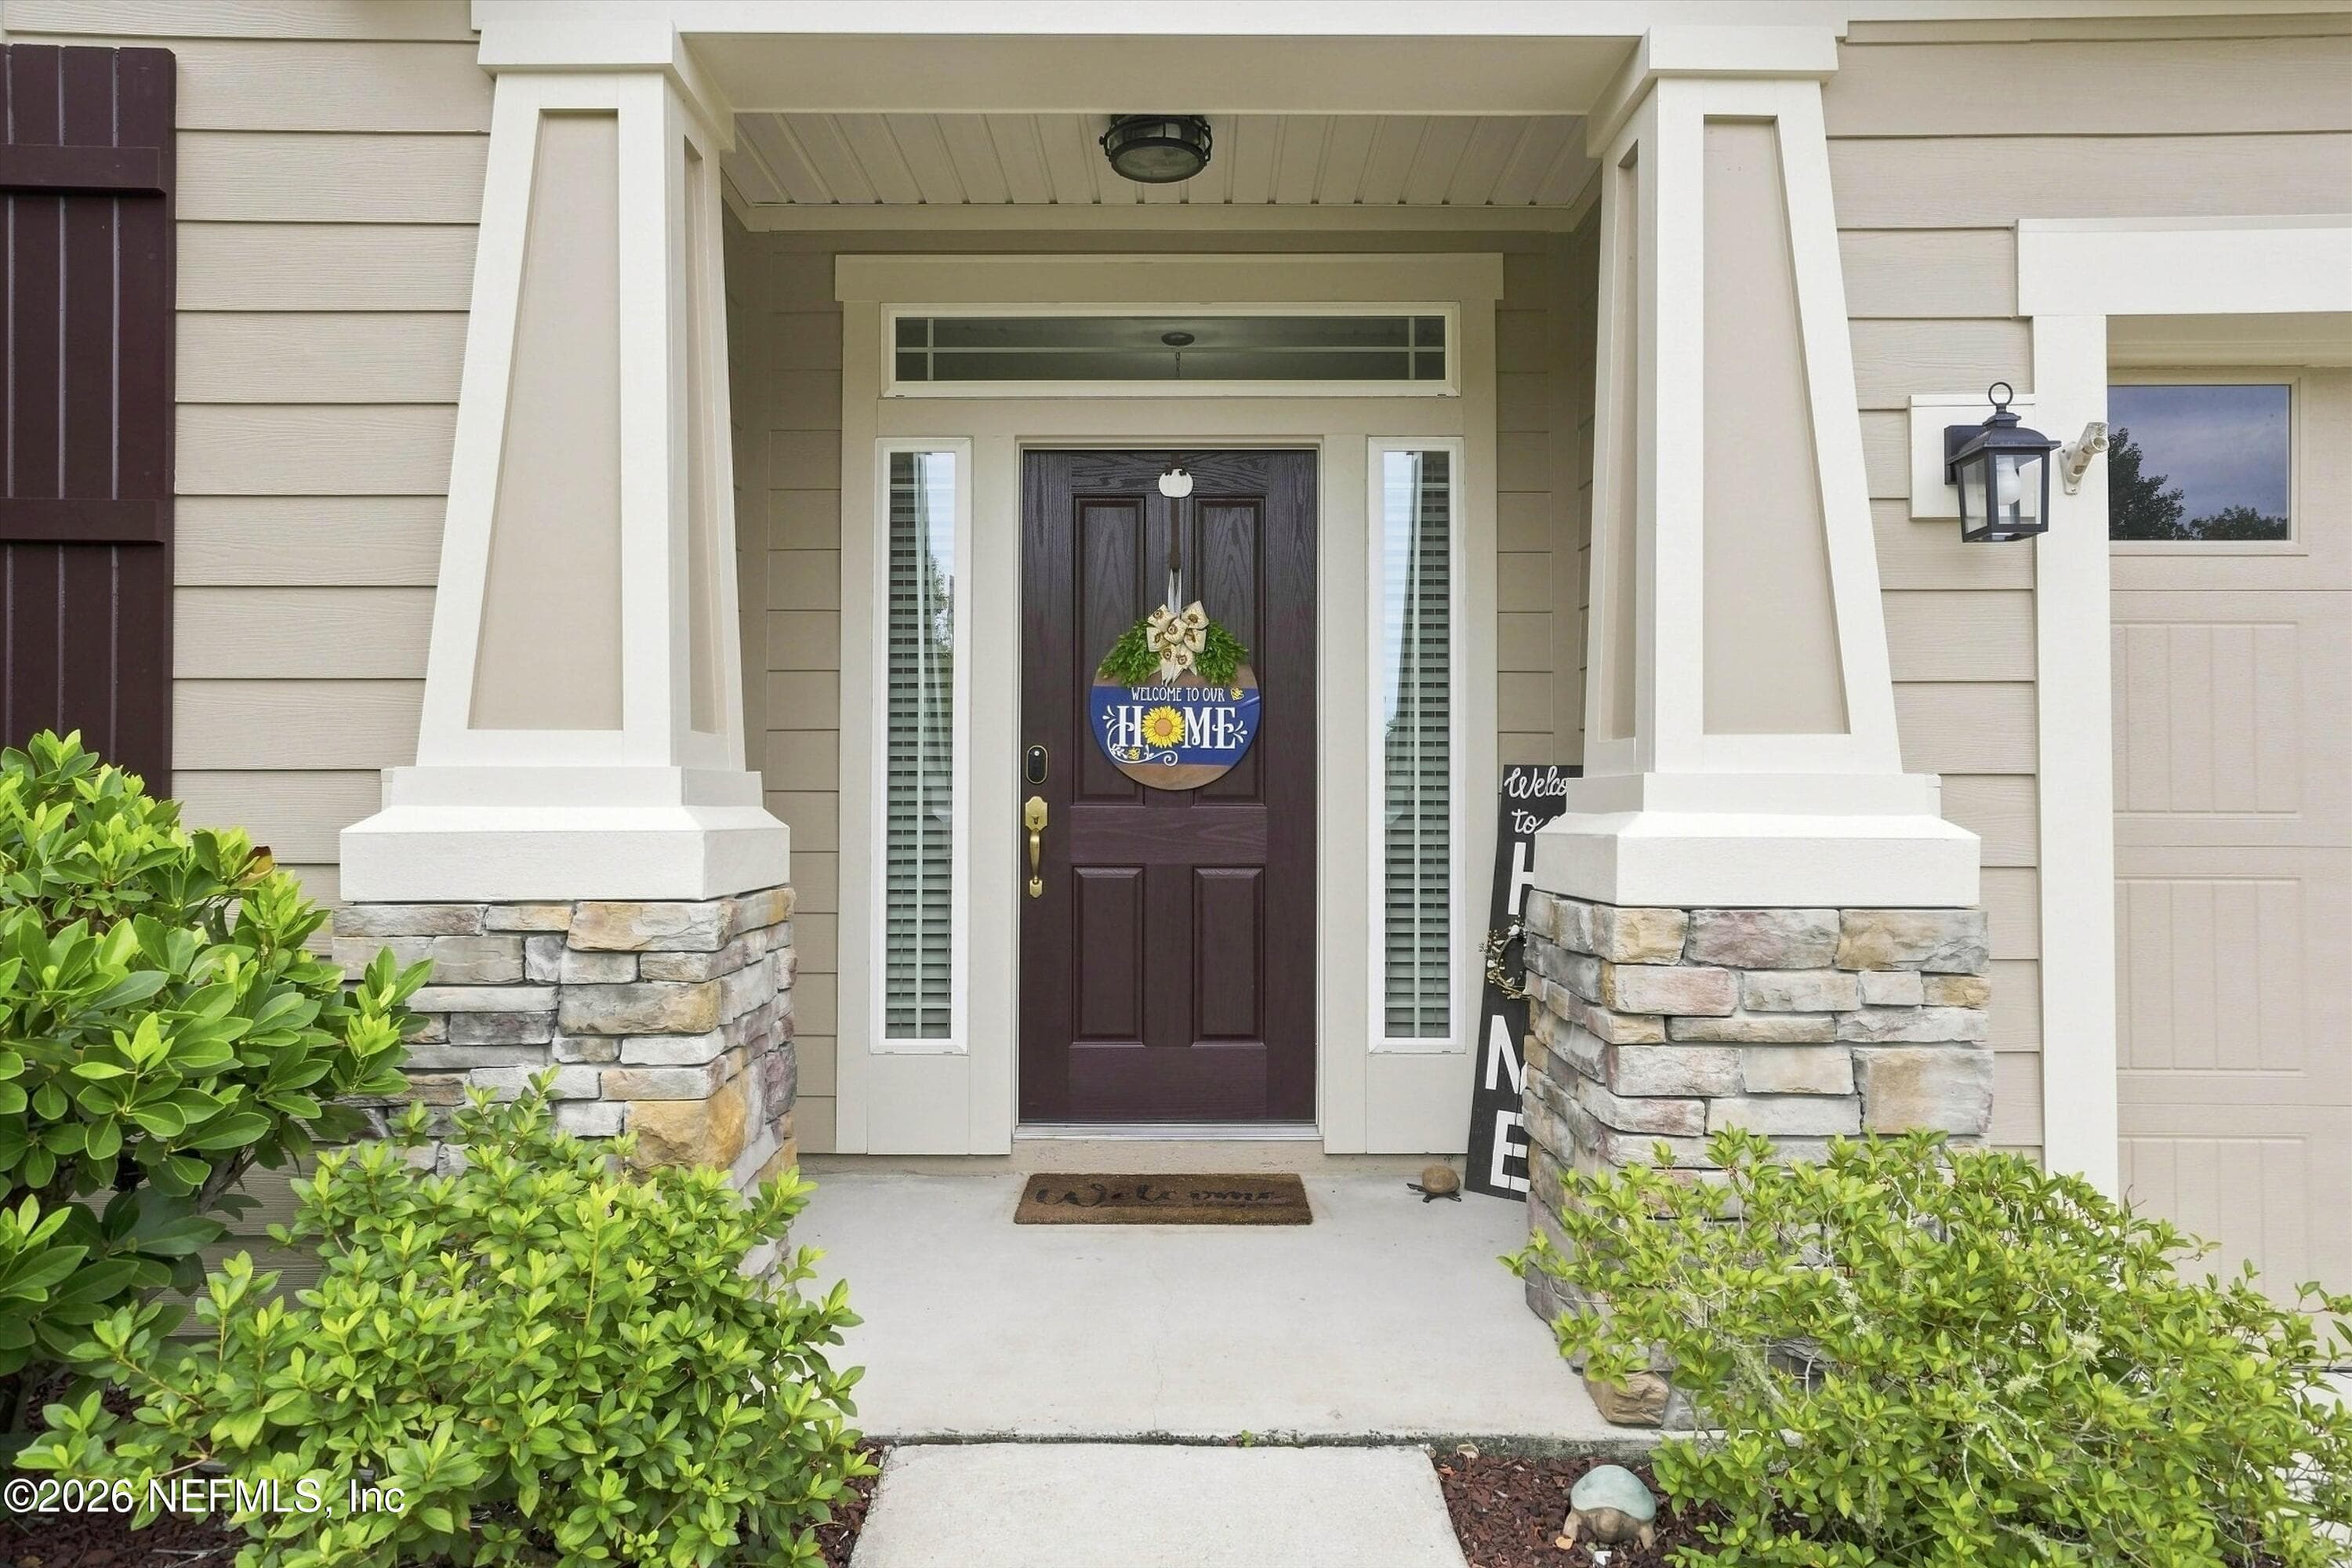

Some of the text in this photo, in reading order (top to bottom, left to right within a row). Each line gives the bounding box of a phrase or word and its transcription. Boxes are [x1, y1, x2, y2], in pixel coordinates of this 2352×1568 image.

[1131, 687, 1225, 702] WELCOME TO OUR
[1116, 706, 1236, 750] HME
[1504, 765, 1568, 799] Welco
[1512, 808, 1544, 834] to
